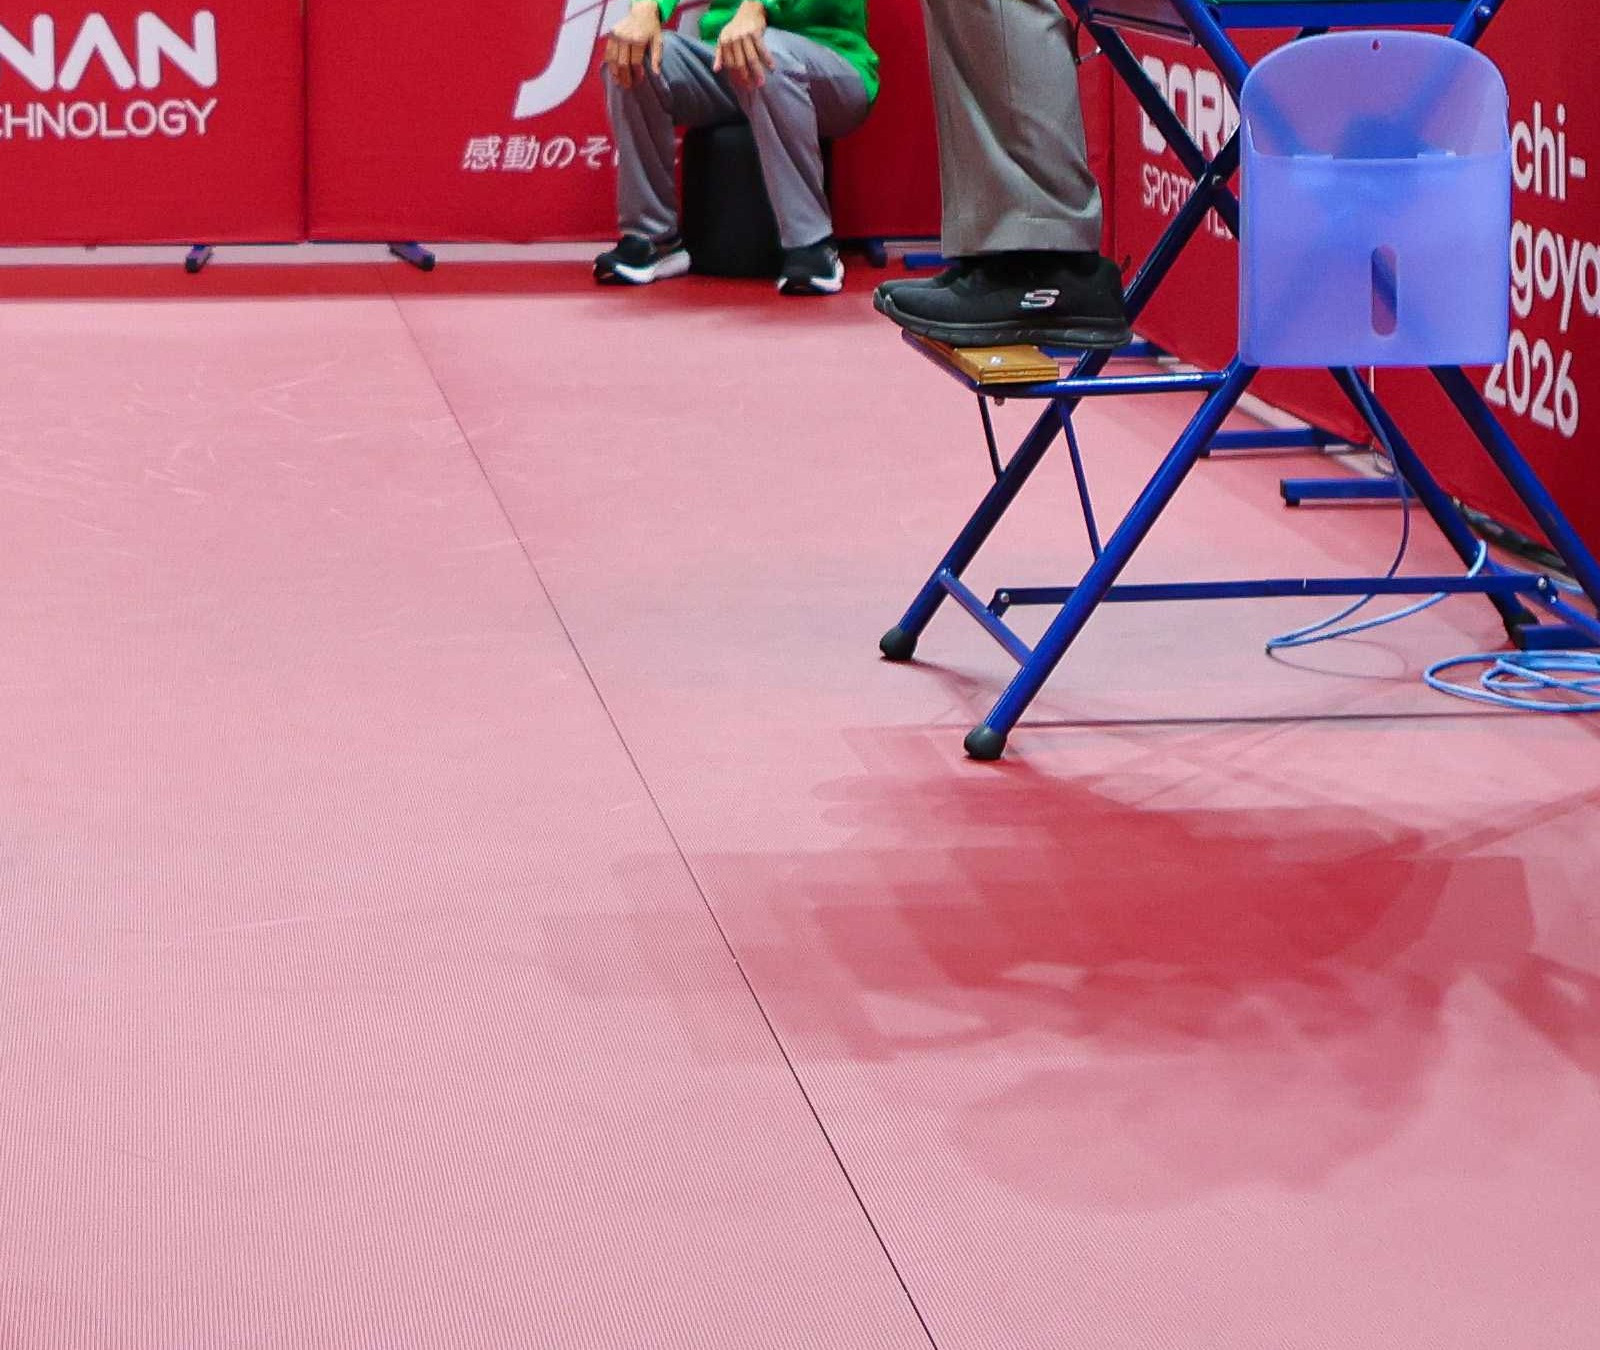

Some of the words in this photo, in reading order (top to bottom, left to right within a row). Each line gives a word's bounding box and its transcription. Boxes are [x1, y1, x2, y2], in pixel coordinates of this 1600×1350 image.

[461, 133, 621, 172] 感動のそ
[1511, 102, 1587, 201] chi-
